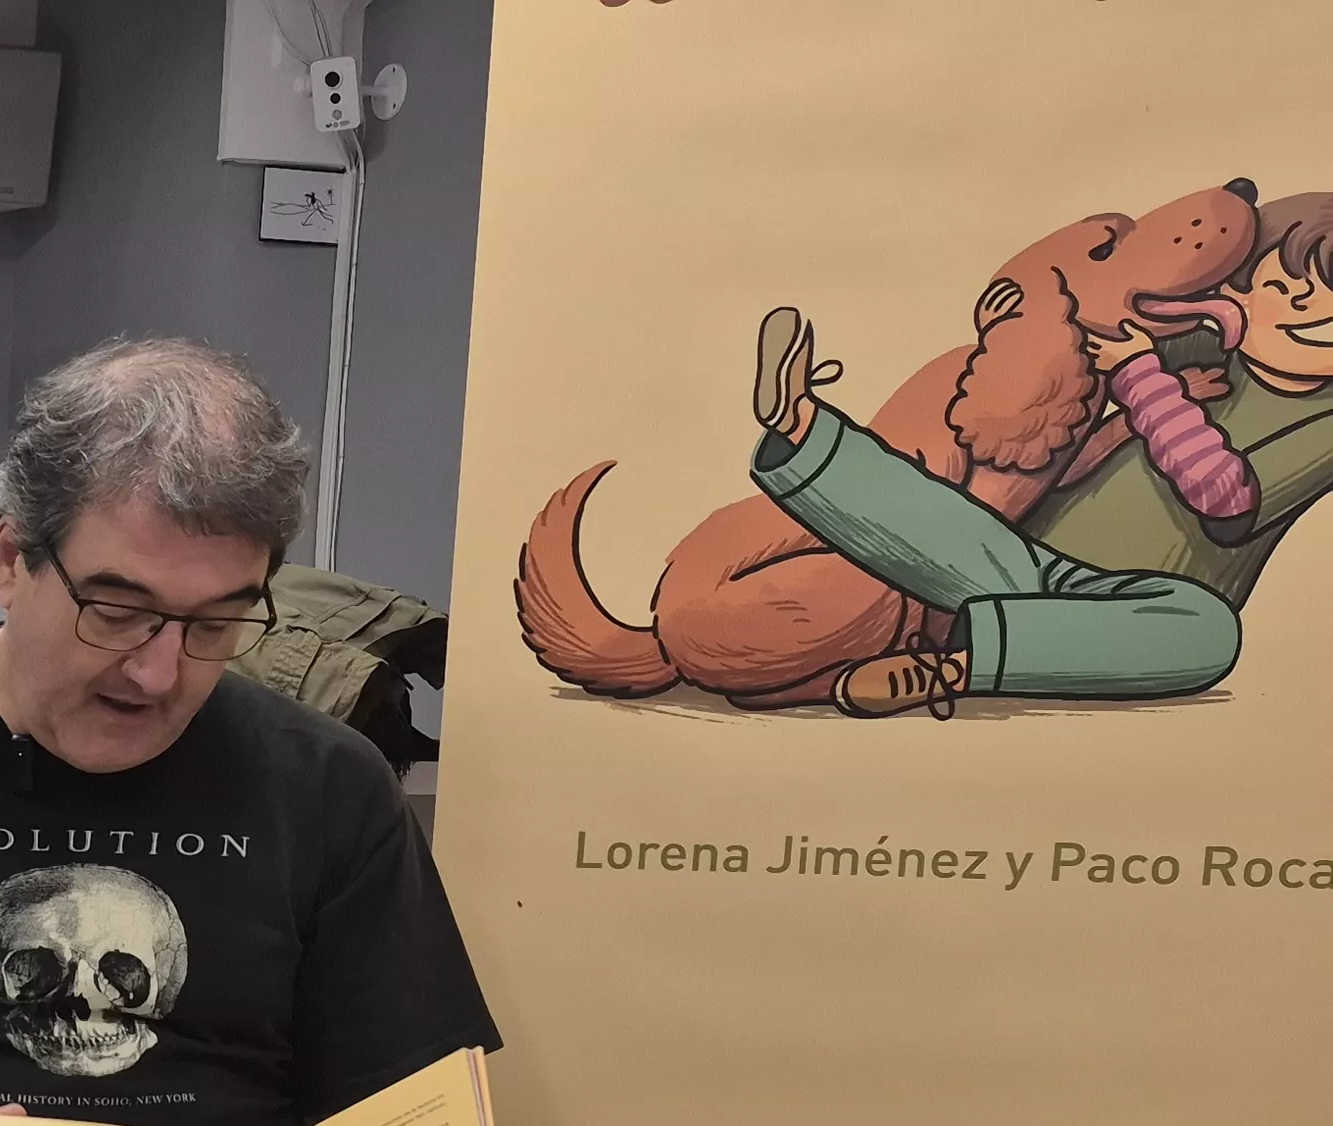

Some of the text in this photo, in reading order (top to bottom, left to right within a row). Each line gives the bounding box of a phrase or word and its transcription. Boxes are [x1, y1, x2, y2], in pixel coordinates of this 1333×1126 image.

[575, 831, 1333, 890] Lorena Jiménez y Paco Roca
[17, 1094, 73, 1106] HISTORY
[77, 1096, 90, 1106] IN
[95, 1095, 132, 1106] SOHO,
[137, 1094, 163, 1104] NEW
[166, 1092, 196, 1103] YORK
